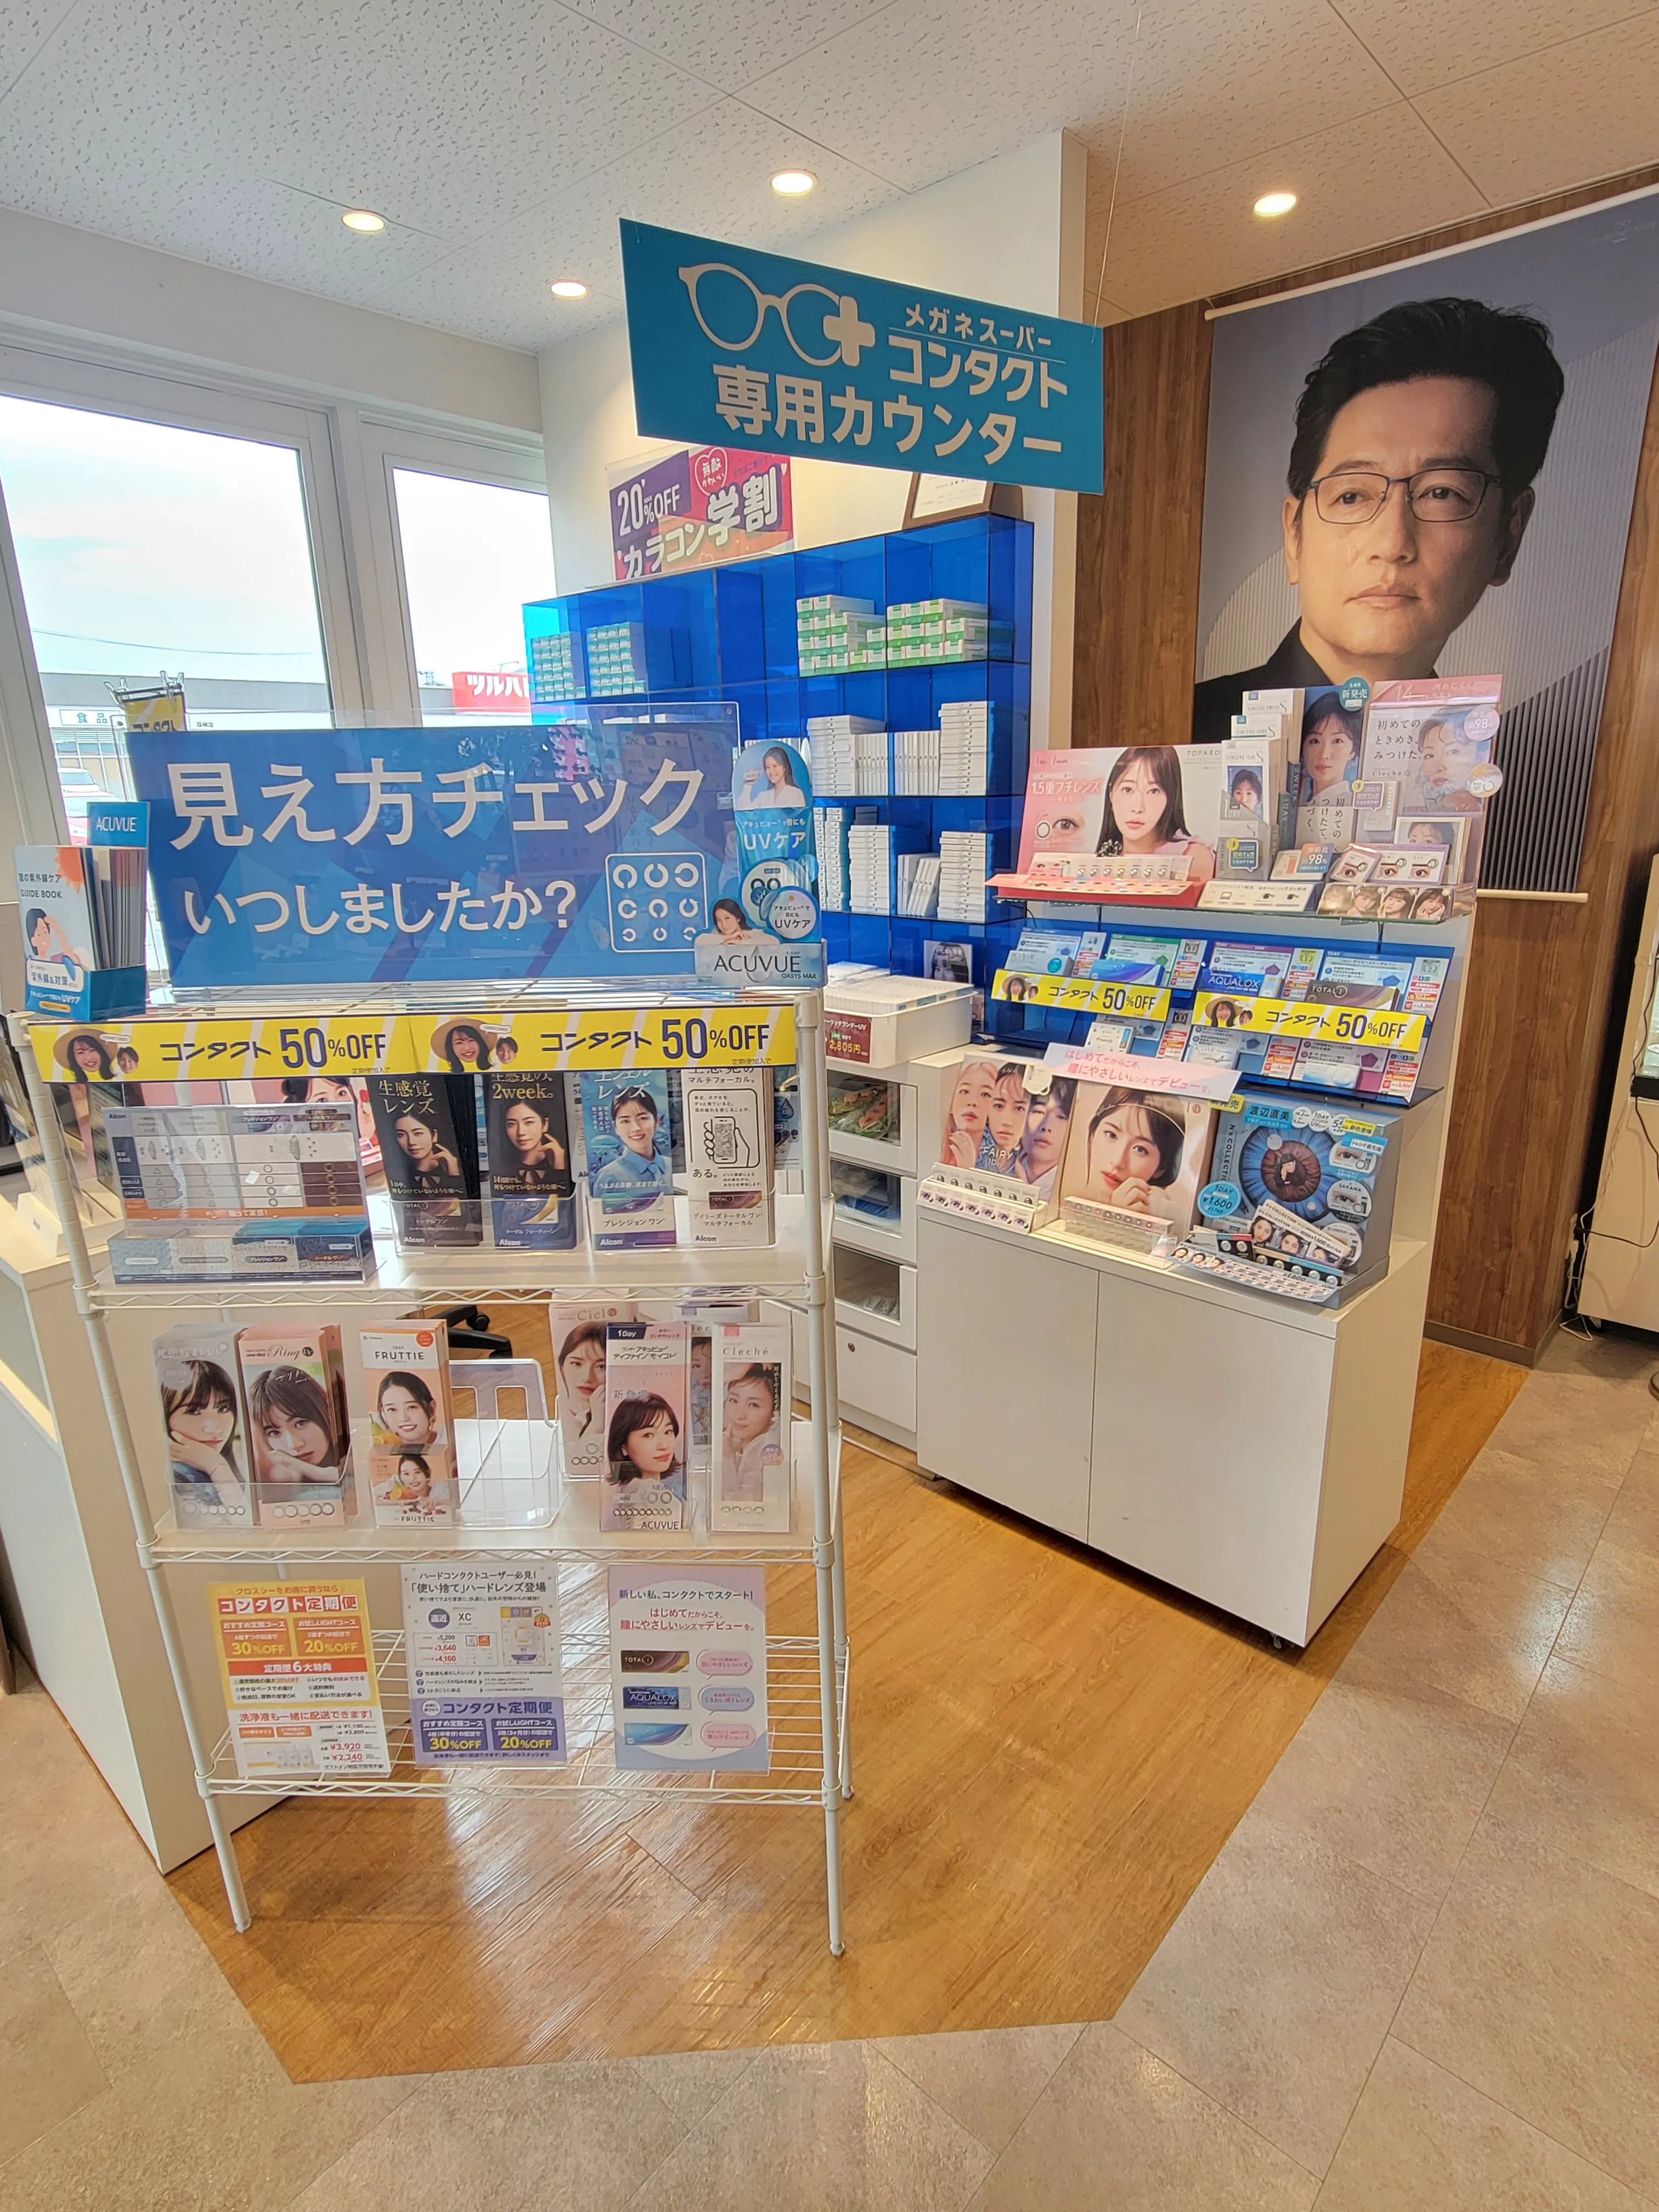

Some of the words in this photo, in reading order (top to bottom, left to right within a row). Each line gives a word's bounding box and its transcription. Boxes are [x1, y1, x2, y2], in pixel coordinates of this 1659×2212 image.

[905, 304, 1052, 352] メガネスーパー
[889, 335, 1068, 408] コンタクト
[713, 364, 1062, 465] 専用カウンター
[1342, 689, 1368, 699] 新発売
[76, 712, 107, 724] 食品
[1378, 719, 1420, 730] 初めての
[1187, 749, 1222, 758] TOPARD
[1374, 750, 1422, 760] みつけた。
[167, 757, 705, 848] 見え方チェック
[95, 816, 137, 832] ACUVUE
[1319, 798, 1330, 840] つけたて、
[1333, 798, 1345, 838] 初めての
[743, 832, 806, 851] UVケア
[21, 889, 39, 898] GUIDE
[41, 890, 63, 899] BOOK
[775, 919, 810, 929] UVケア
[713, 955, 802, 973] ACUVUE
[1208, 975, 1261, 989] AQUALOX
[1048, 986, 1099, 1002] コンタクト
[1266, 1010, 1331, 1028] コンタクト
[540, 1031, 652, 1052] コンタクト
[829, 1040, 860, 1054] 2,805円
[159, 1040, 272, 1062] コンタクト
[379, 1080, 432, 1097] 生感覚
[599, 1081, 651, 1099] レンズ
[383, 1098, 435, 1114] レンズ
[983, 1146, 1013, 1160] FAIRY
[1220, 1139, 1233, 1182] COLLECTI
[692, 1169, 718, 1178] ある。
[1215, 1184, 1234, 1195] 1DAY
[578, 1309, 605, 1321] Ciel
[617, 1329, 637, 1338] 1Day
[375, 1352, 425, 1360] FRUTTIE
[723, 1347, 769, 1356] Cleché
[613, 1389, 648, 1400] 新登場
[641, 1521, 679, 1530] ACUVUE
[411, 1582, 547, 1594] 「使い捨て」ハードレンズ登場
[221, 1596, 357, 1612] コンタクト定期便
[458, 1612, 472, 1622] XC
[650, 1607, 723, 1618] はじめてだからこそ、
[232, 1642, 285, 1655] 30%OFF
[303, 1640, 358, 1652] 20%OFF
[630, 1693, 676, 1702] AQUALOX
[443, 1702, 553, 1714] コンタクト定期便
[429, 1737, 482, 1750] 30%OFF
[500, 1736, 552, 1749] 20%OFF
